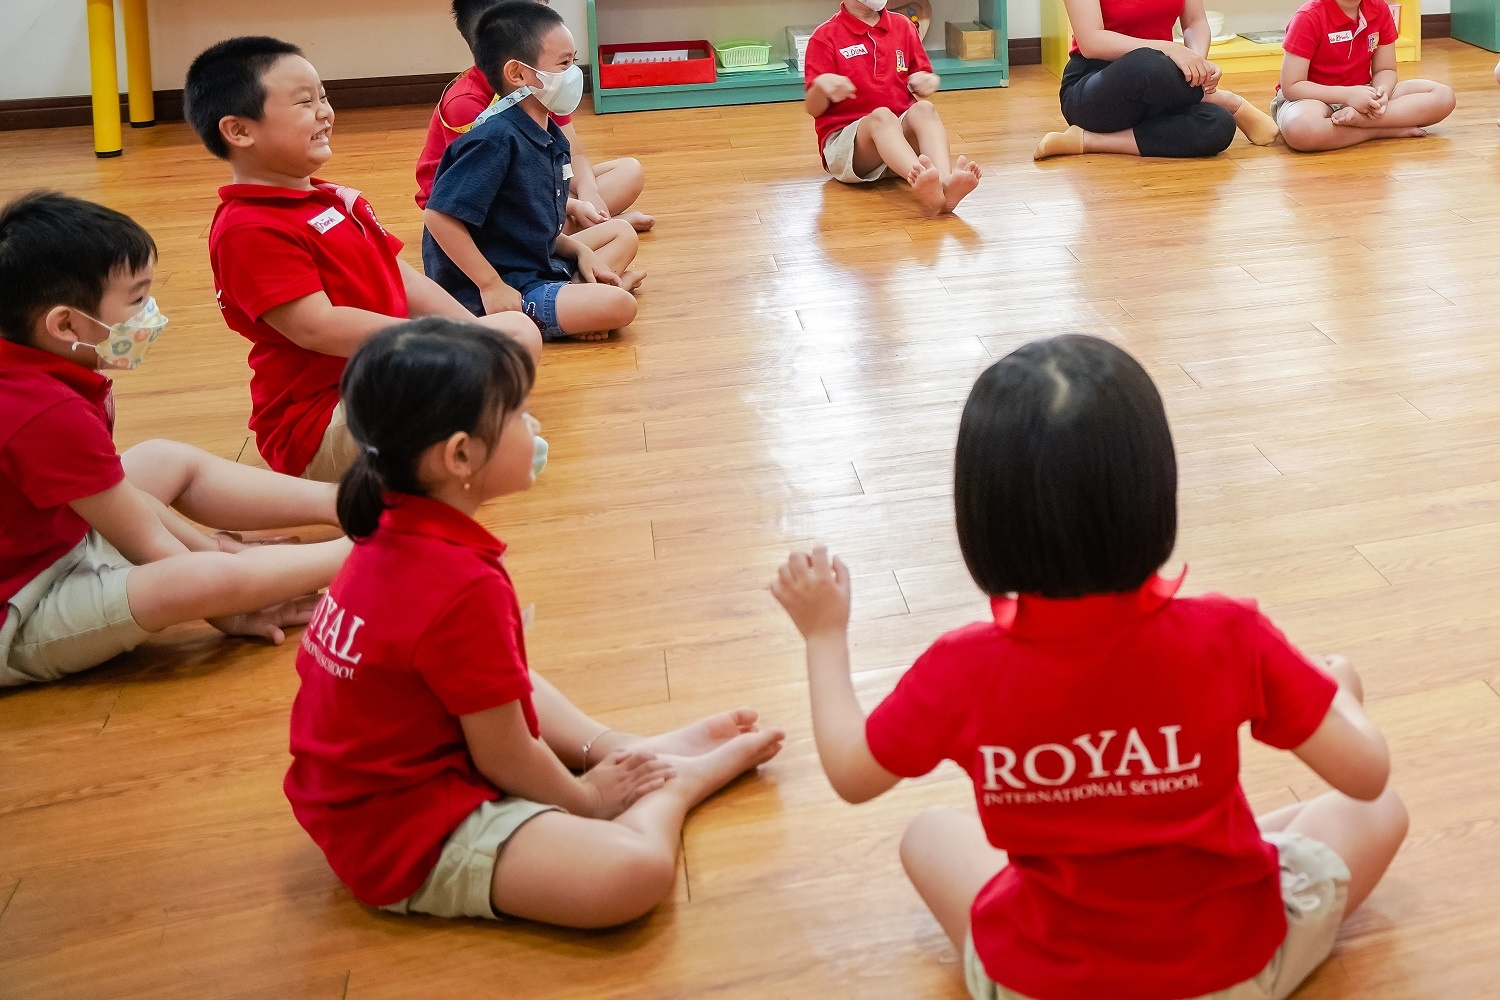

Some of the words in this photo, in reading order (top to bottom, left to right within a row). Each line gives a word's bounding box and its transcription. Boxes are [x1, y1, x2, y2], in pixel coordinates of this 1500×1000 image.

[978, 724, 1201, 790] ROYAL
[983, 780, 1127, 806] INTERNATIONAL
[1129, 773, 1201, 795] SCHOOL
